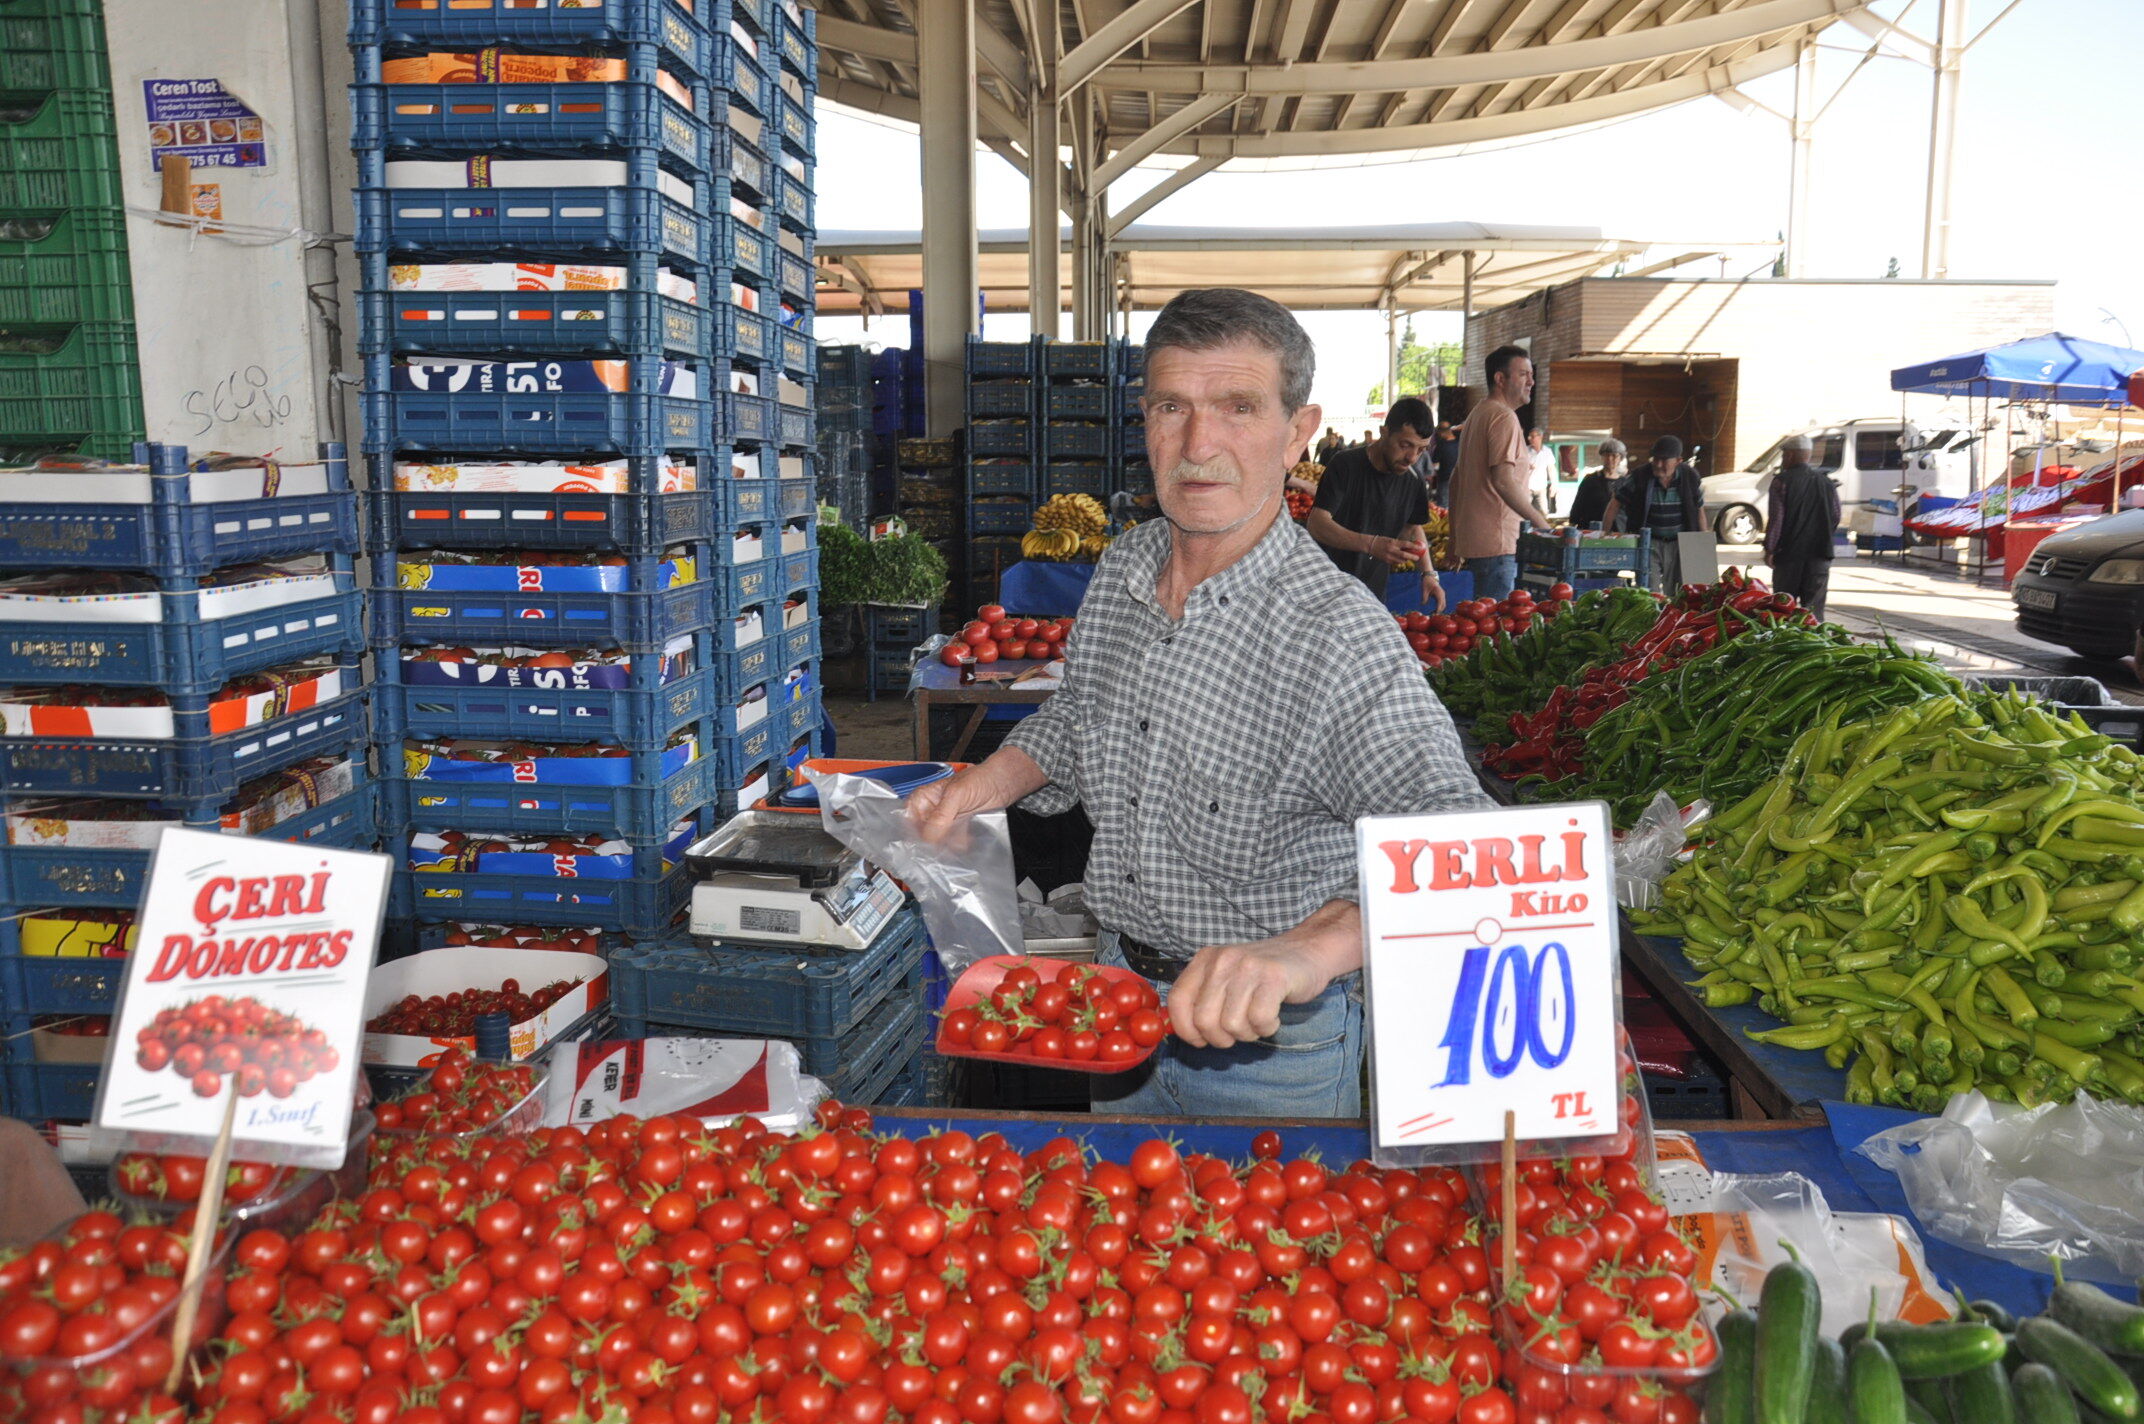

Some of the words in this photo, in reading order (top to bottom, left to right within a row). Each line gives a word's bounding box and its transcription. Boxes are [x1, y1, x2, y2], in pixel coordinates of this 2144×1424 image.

[152, 83, 189, 96] Ceren
[189, 81, 218, 94] Tost
[207, 154, 221, 166] 67
[222, 153, 237, 165] 45
[1378, 818, 1588, 893] YERLİ
[193, 860, 333, 937] ÇERİ
[145, 930, 354, 983] DOMOTES
[1429, 942, 1576, 1089] 100
[1551, 1091, 1593, 1119] TL
